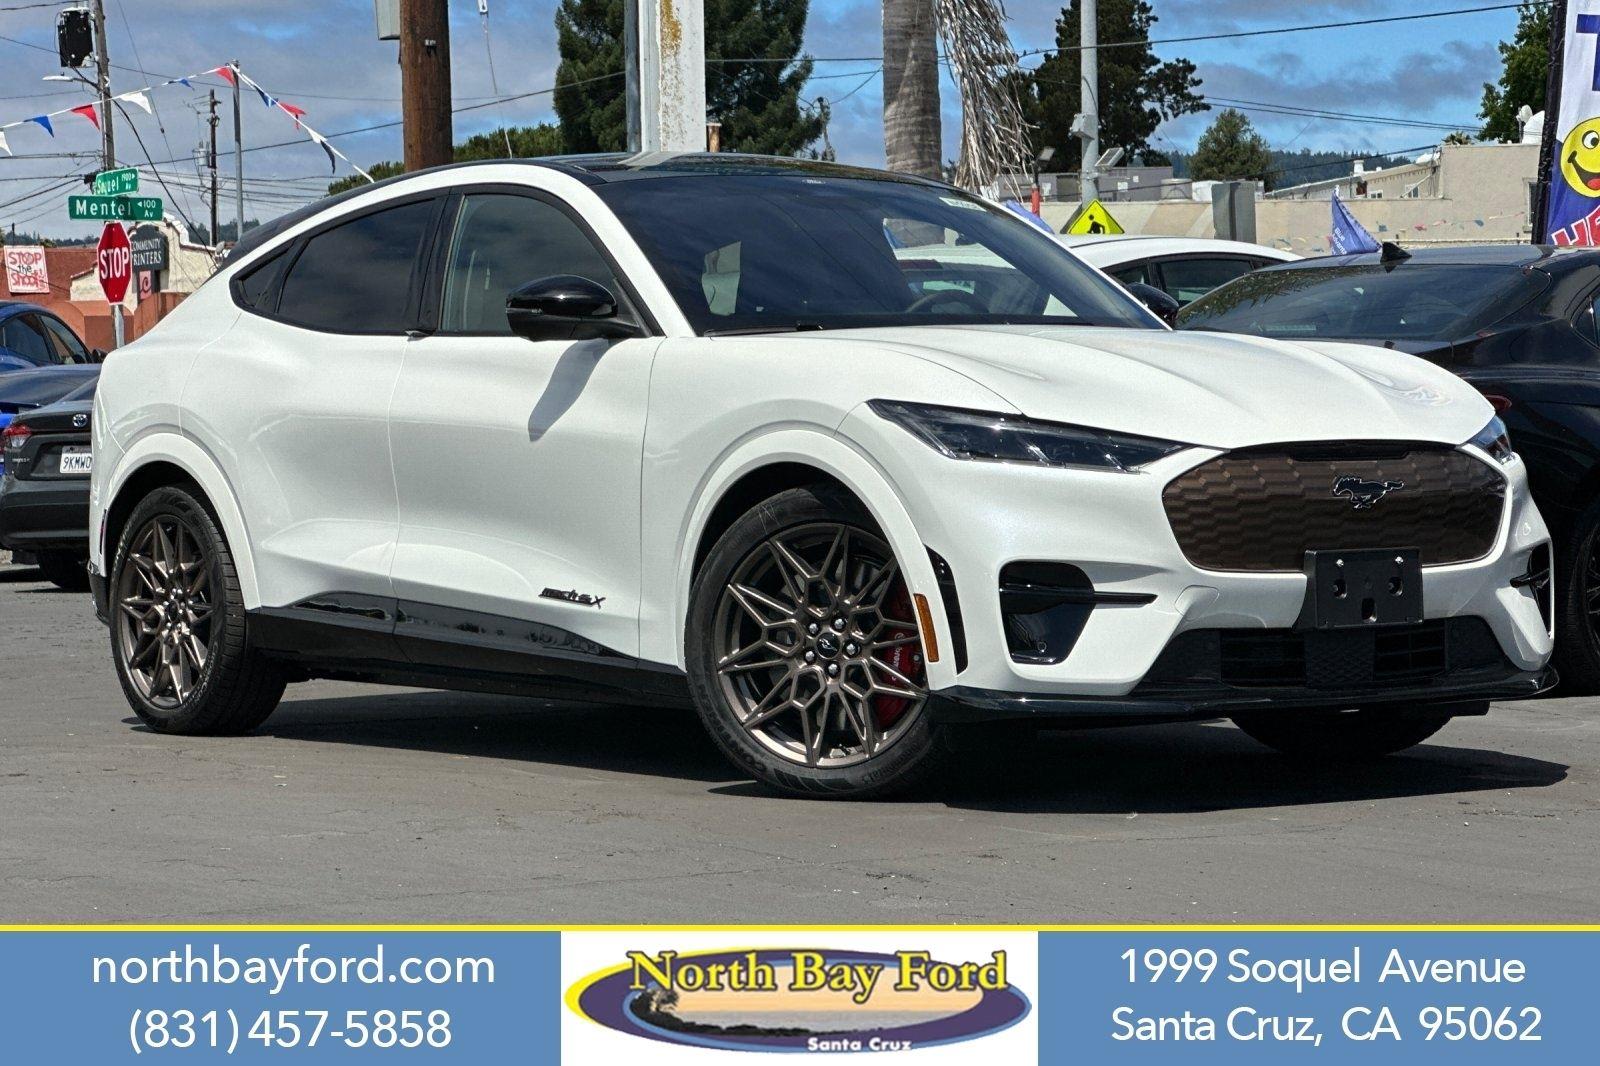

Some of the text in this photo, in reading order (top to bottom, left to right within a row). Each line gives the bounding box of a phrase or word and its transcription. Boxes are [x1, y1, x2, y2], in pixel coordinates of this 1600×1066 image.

[75, 199, 156, 218] Mentel 100 Av
[132, 237, 161, 251] OMMUNITY
[8, 251, 42, 265] STOP
[100, 246, 130, 280] STOP
[132, 250, 162, 266] RINTERS
